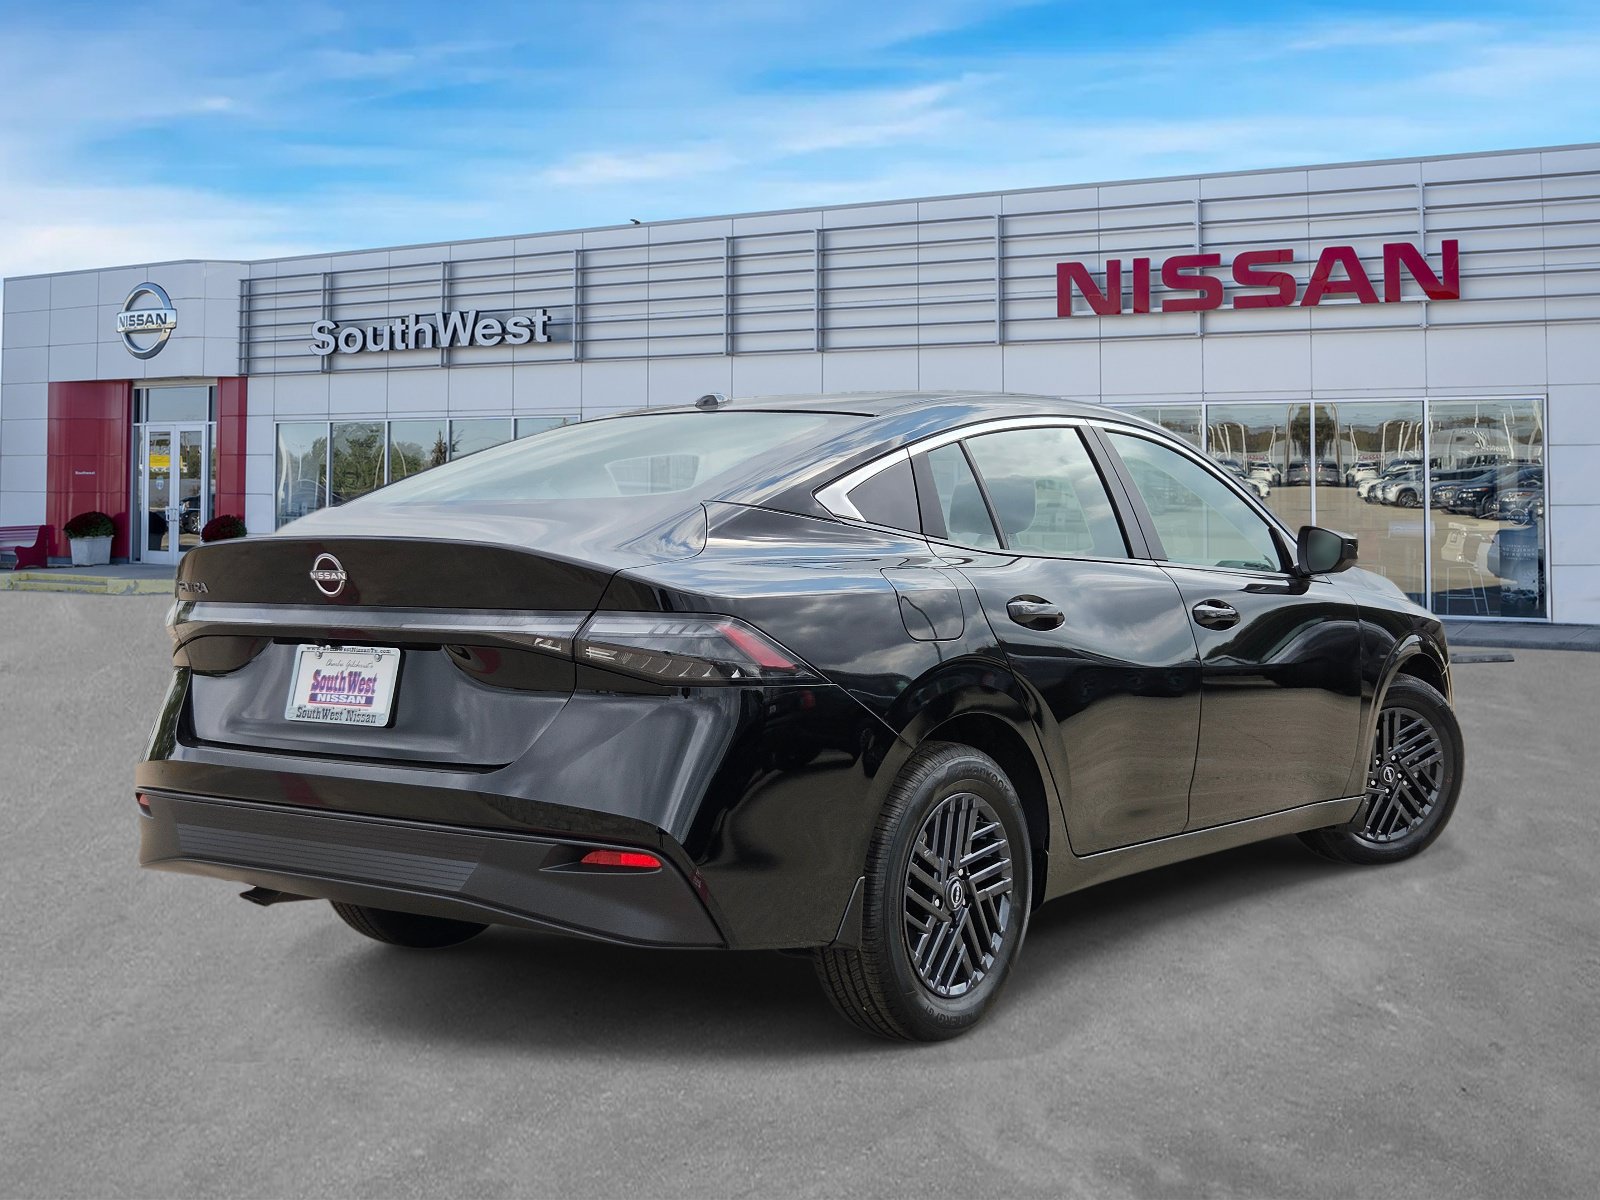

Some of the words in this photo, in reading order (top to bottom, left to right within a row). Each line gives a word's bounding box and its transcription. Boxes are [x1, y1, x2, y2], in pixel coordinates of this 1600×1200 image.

[1057, 240, 1460, 317] NISSAN
[119, 313, 167, 328] NISSAN
[309, 308, 551, 356] SouthWest
[310, 571, 346, 580] NISSAN
[316, 693, 366, 704] NISSAN
[296, 705, 343, 721] SouthWest
[345, 710, 377, 724] Nissan
